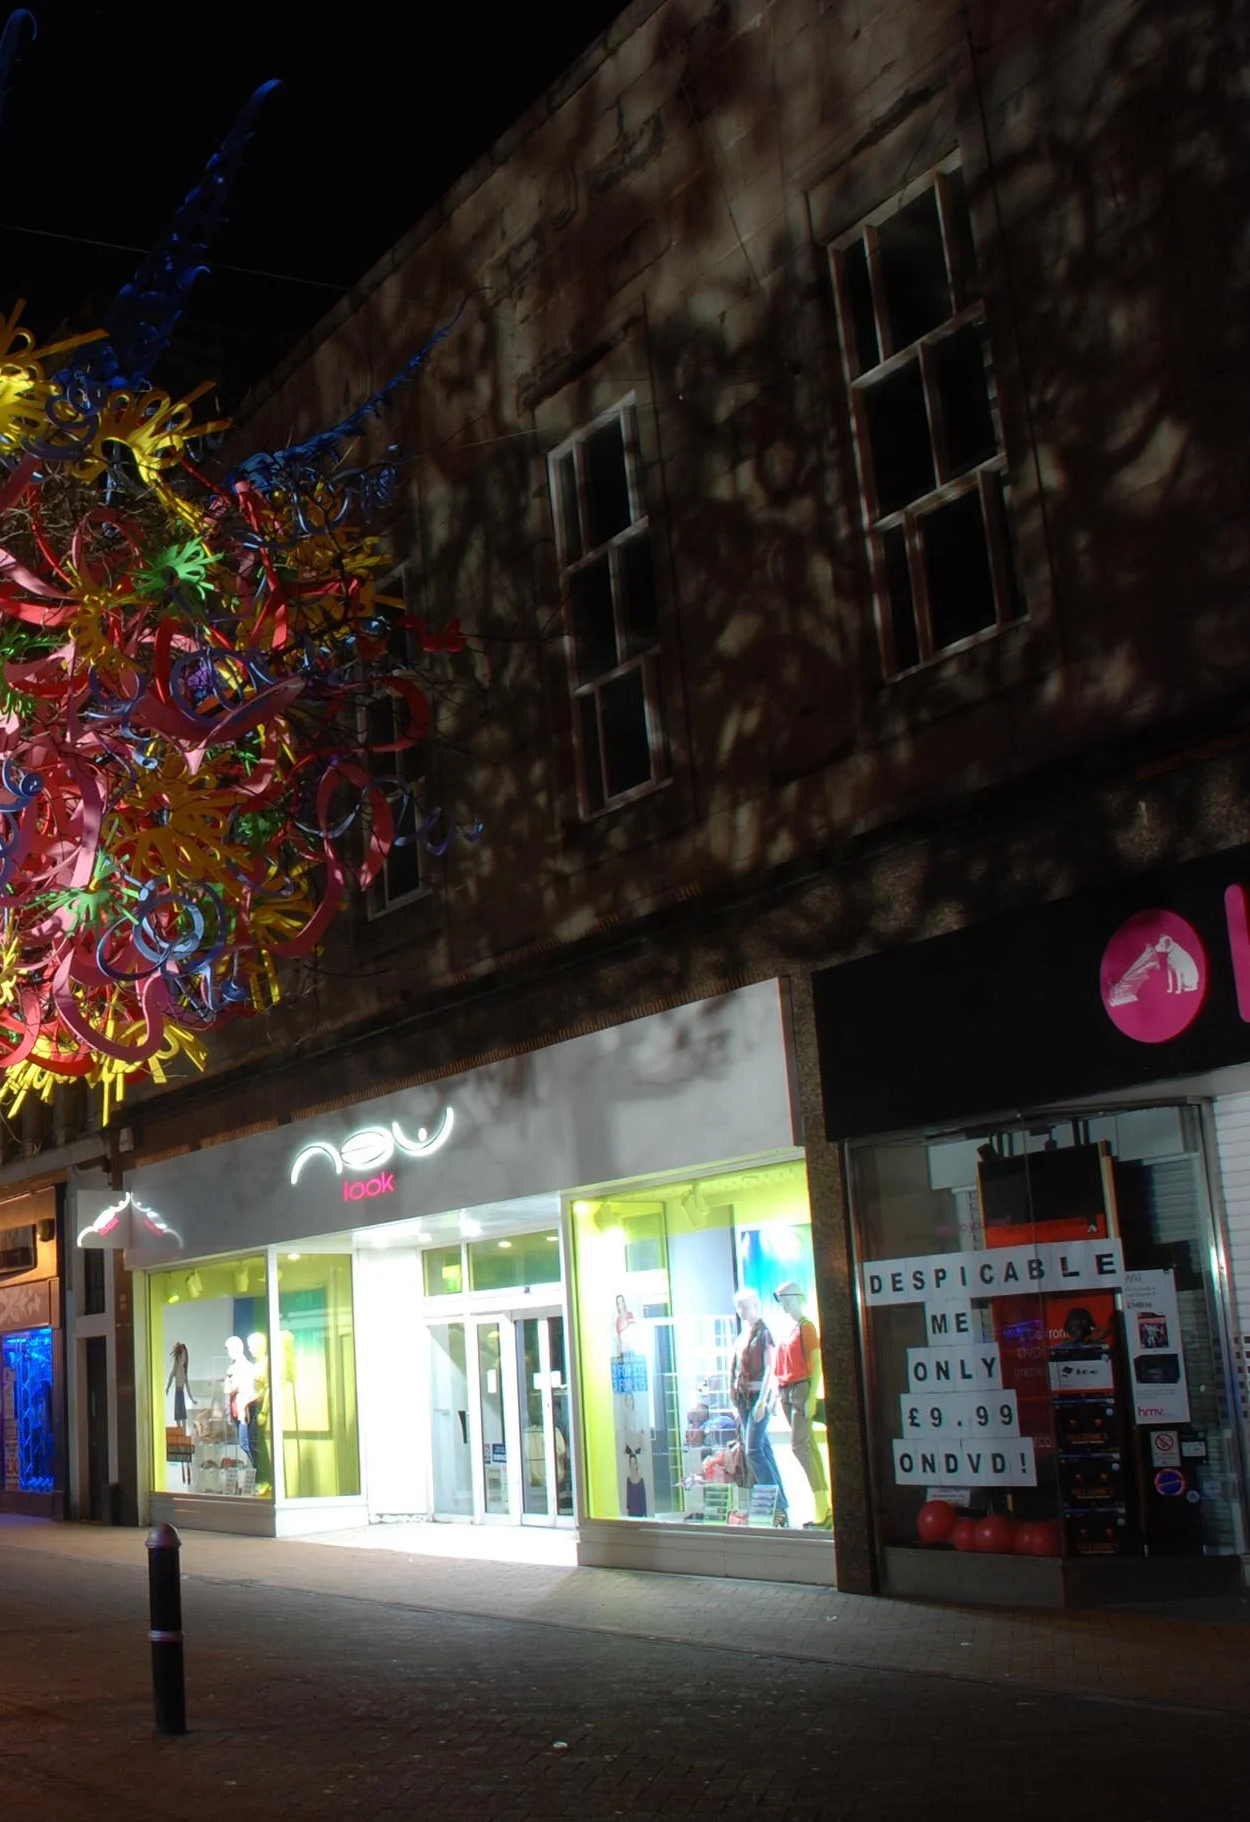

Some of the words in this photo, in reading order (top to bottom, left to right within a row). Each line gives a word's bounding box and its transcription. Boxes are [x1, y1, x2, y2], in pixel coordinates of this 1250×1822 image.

[290, 1105, 455, 1185] new
[342, 1171, 396, 1202] look
[870, 1253, 1118, 1295] DESPICABLE
[931, 1315, 969, 1335] ME
[913, 1357, 998, 1382] ONLY
[908, 1404, 1014, 1428] £9.99
[1137, 1405, 1163, 1416] hmv
[899, 1452, 1028, 1474] ONDVD!
